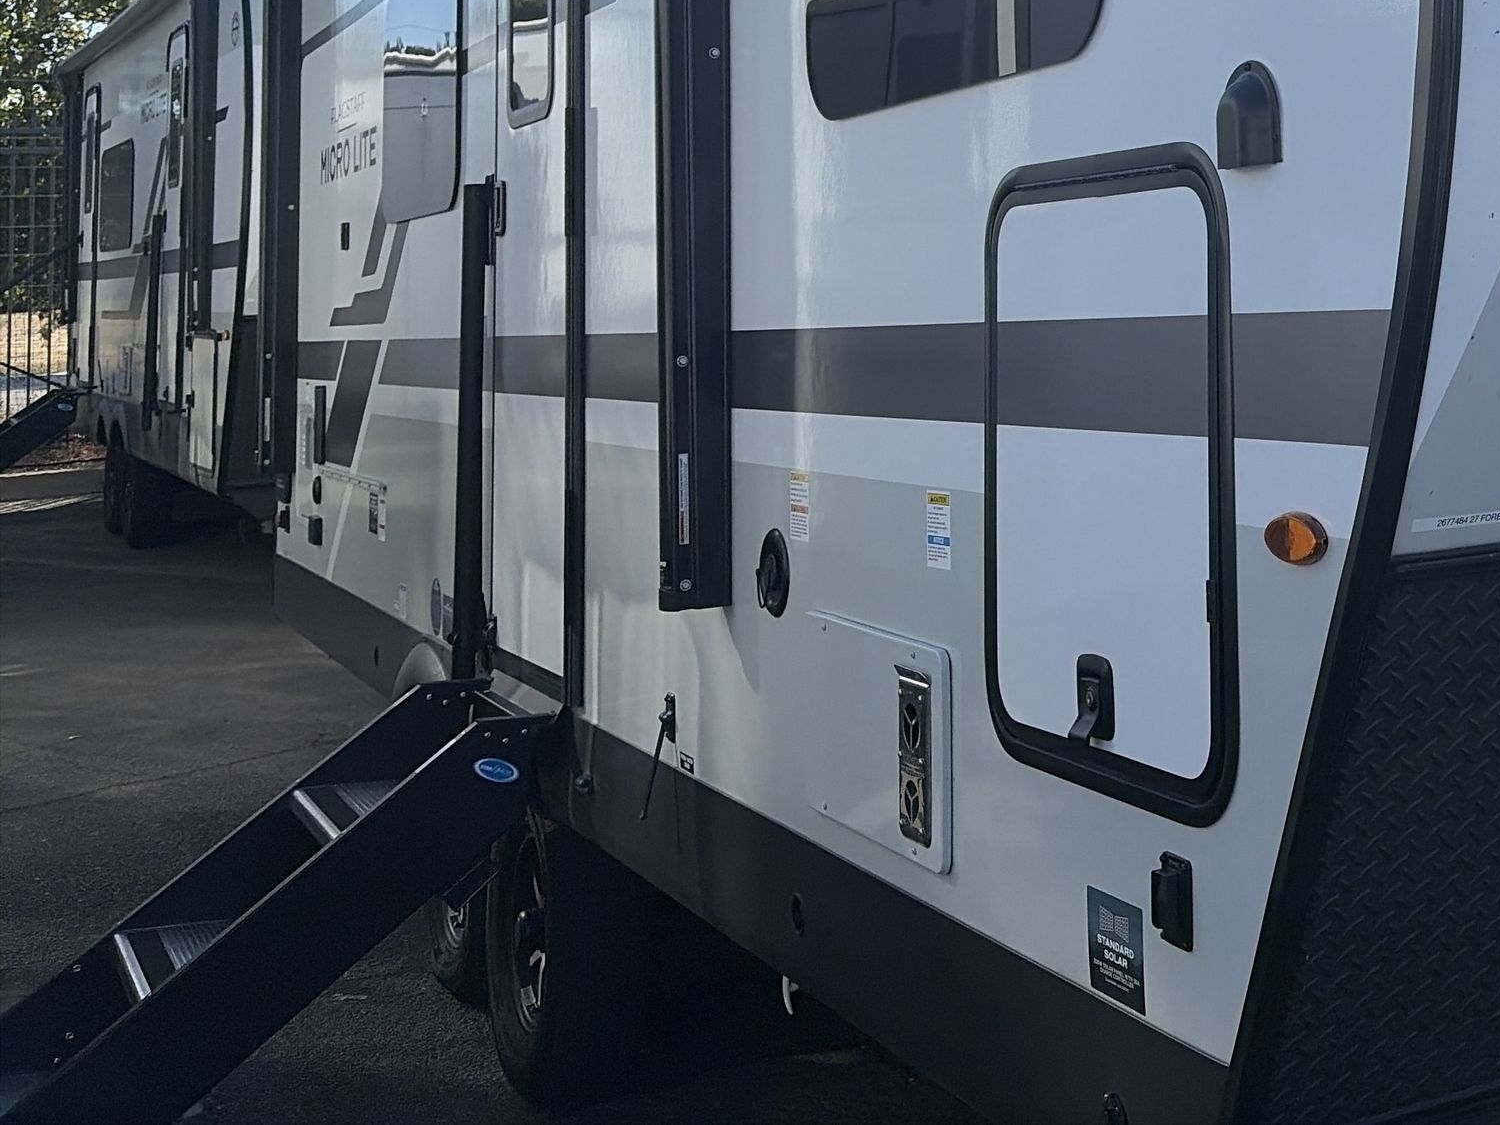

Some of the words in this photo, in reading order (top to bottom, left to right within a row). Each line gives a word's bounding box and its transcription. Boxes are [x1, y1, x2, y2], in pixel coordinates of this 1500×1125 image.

[320, 138, 351, 186] MICRO
[353, 125, 377, 173] LITE
[1469, 515, 1480, 524] 27
[1096, 933, 1135, 959] STANDARD
[1103, 949, 1128, 969] SOLAR
